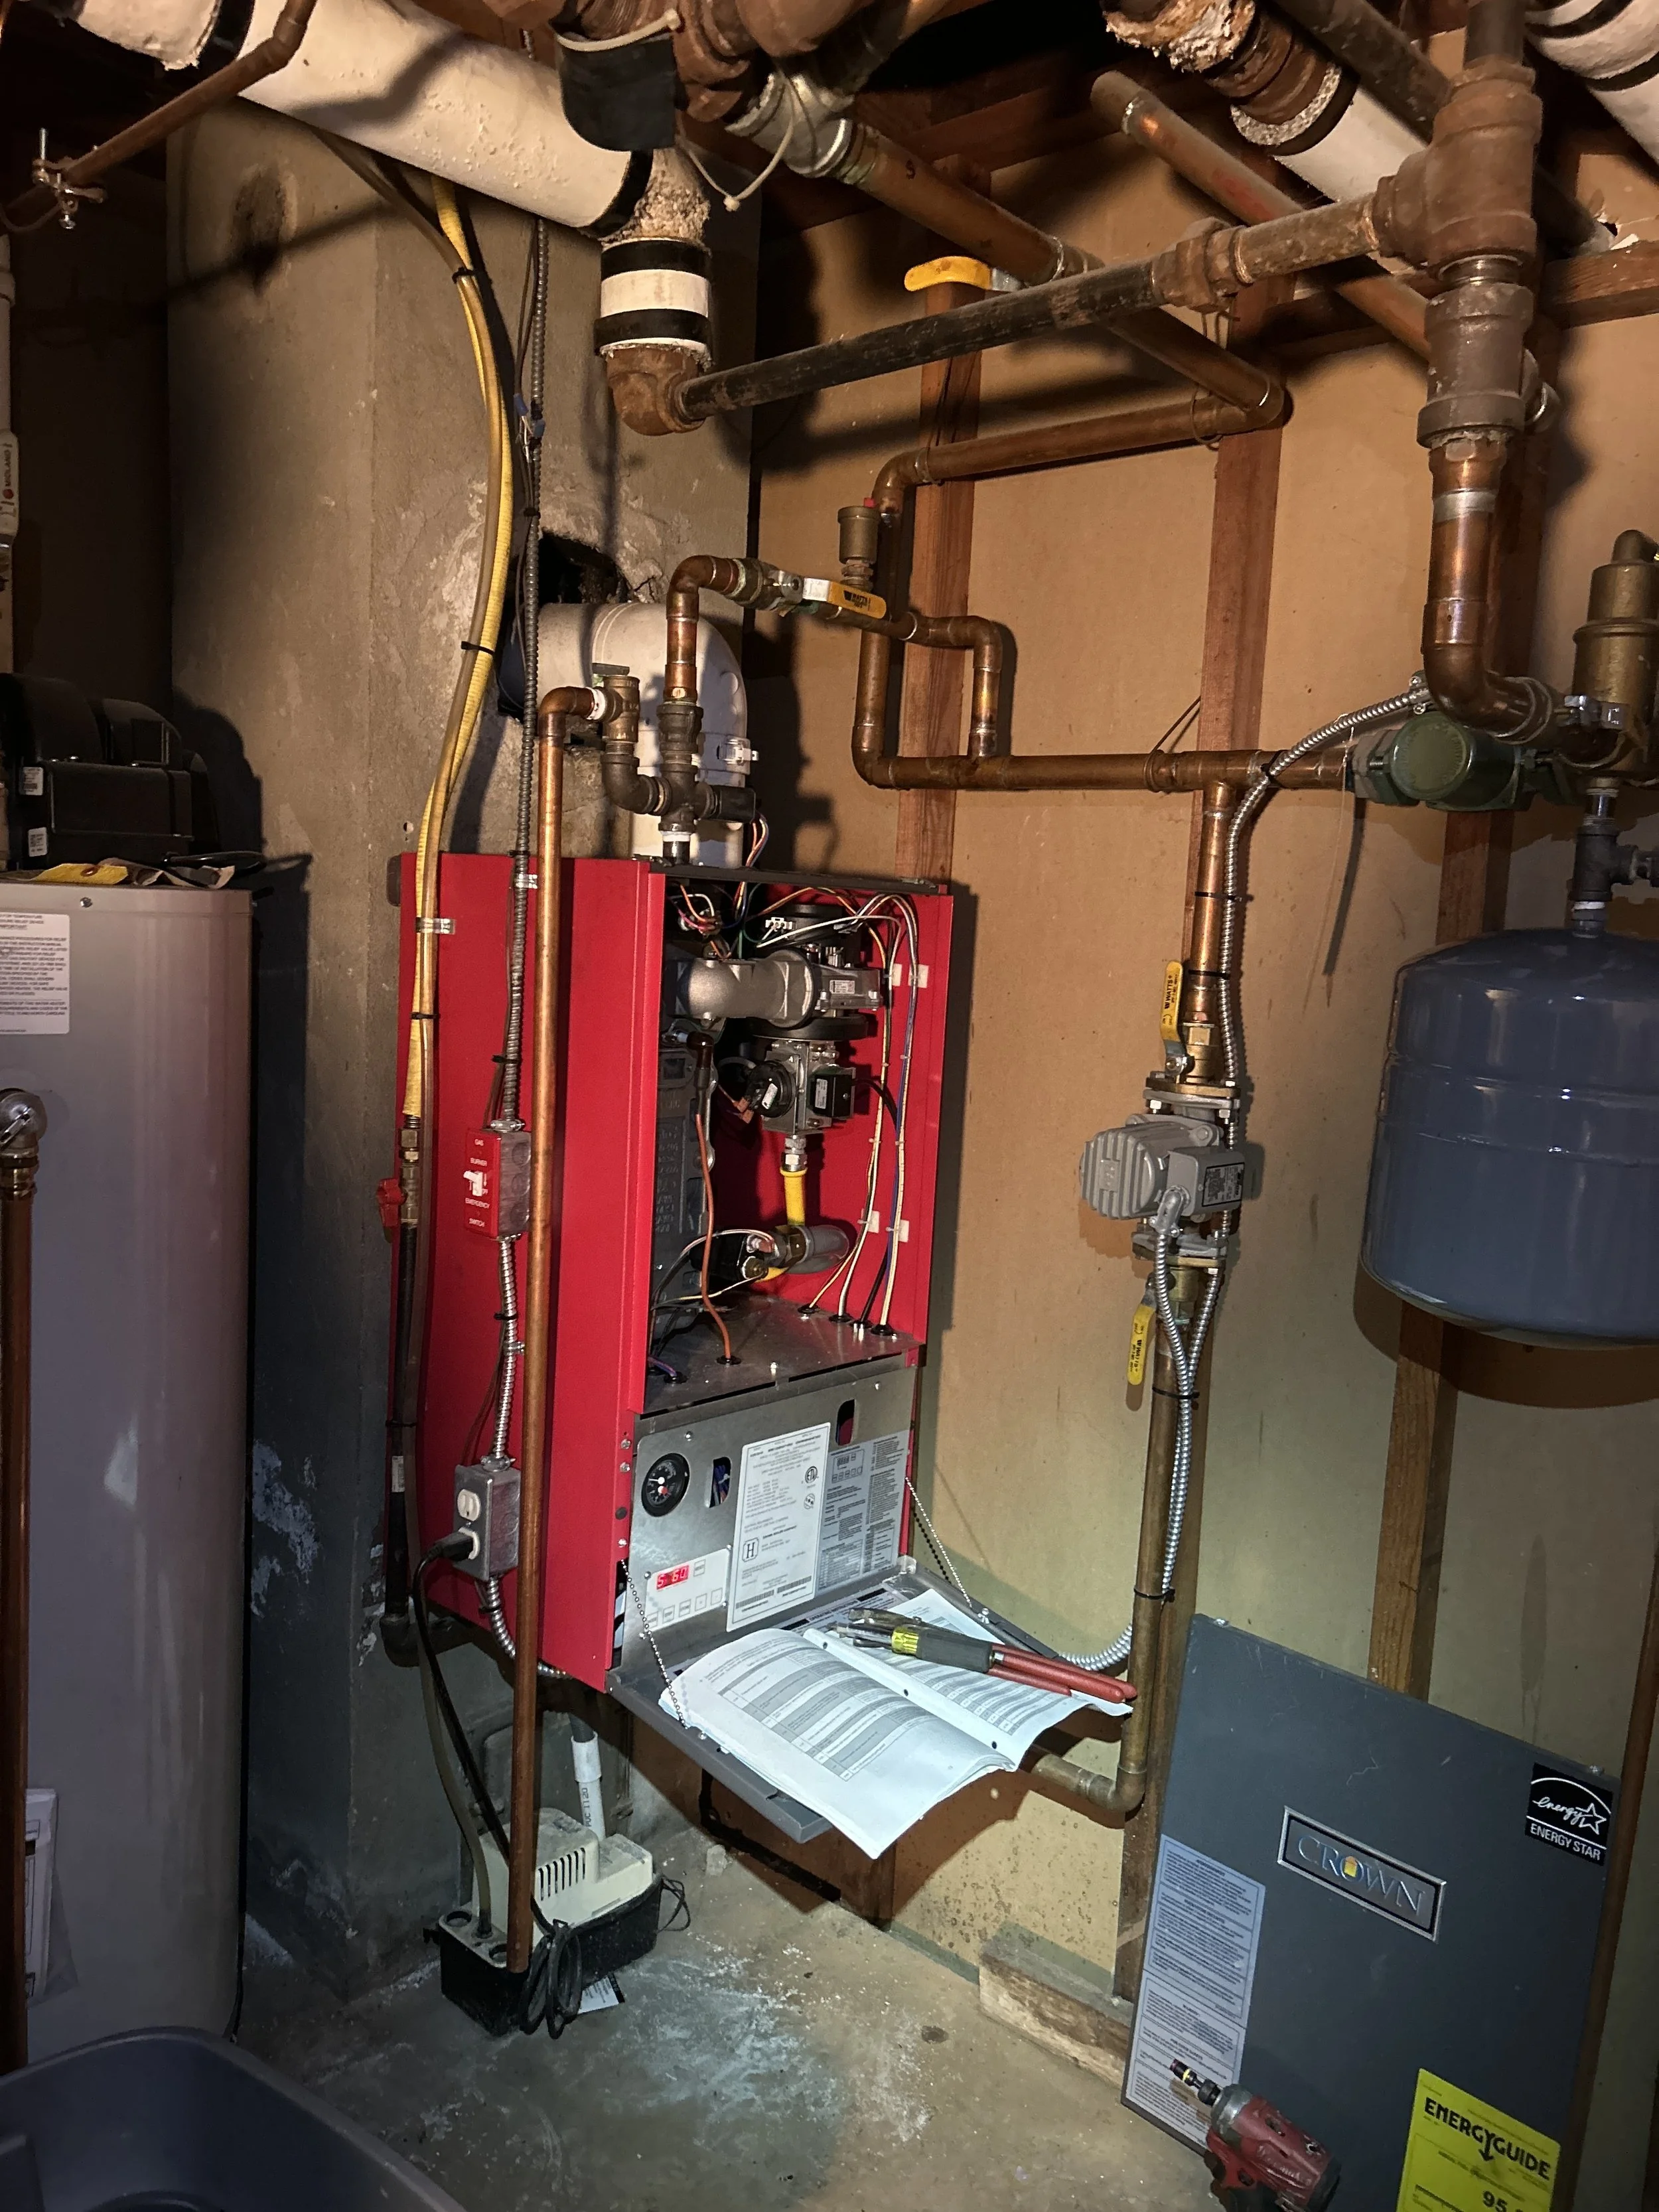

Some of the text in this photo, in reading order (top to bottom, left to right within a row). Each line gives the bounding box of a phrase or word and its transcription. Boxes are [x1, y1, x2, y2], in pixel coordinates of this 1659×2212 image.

[470, 1157, 488, 1167] BURNER
[465, 1197, 490, 1209] EMERGENCY
[469, 1218, 485, 1227] SWITCH
[746, 1543, 755, 1559] H
[672, 1567, 687, 1582] 60
[1532, 1797, 1583, 1825] energy
[1530, 1823, 1601, 1861] ENERGY STAR
[1298, 1835, 1425, 1916] CROWN
[1424, 2097, 1551, 2181] ENERGYGUIDE
